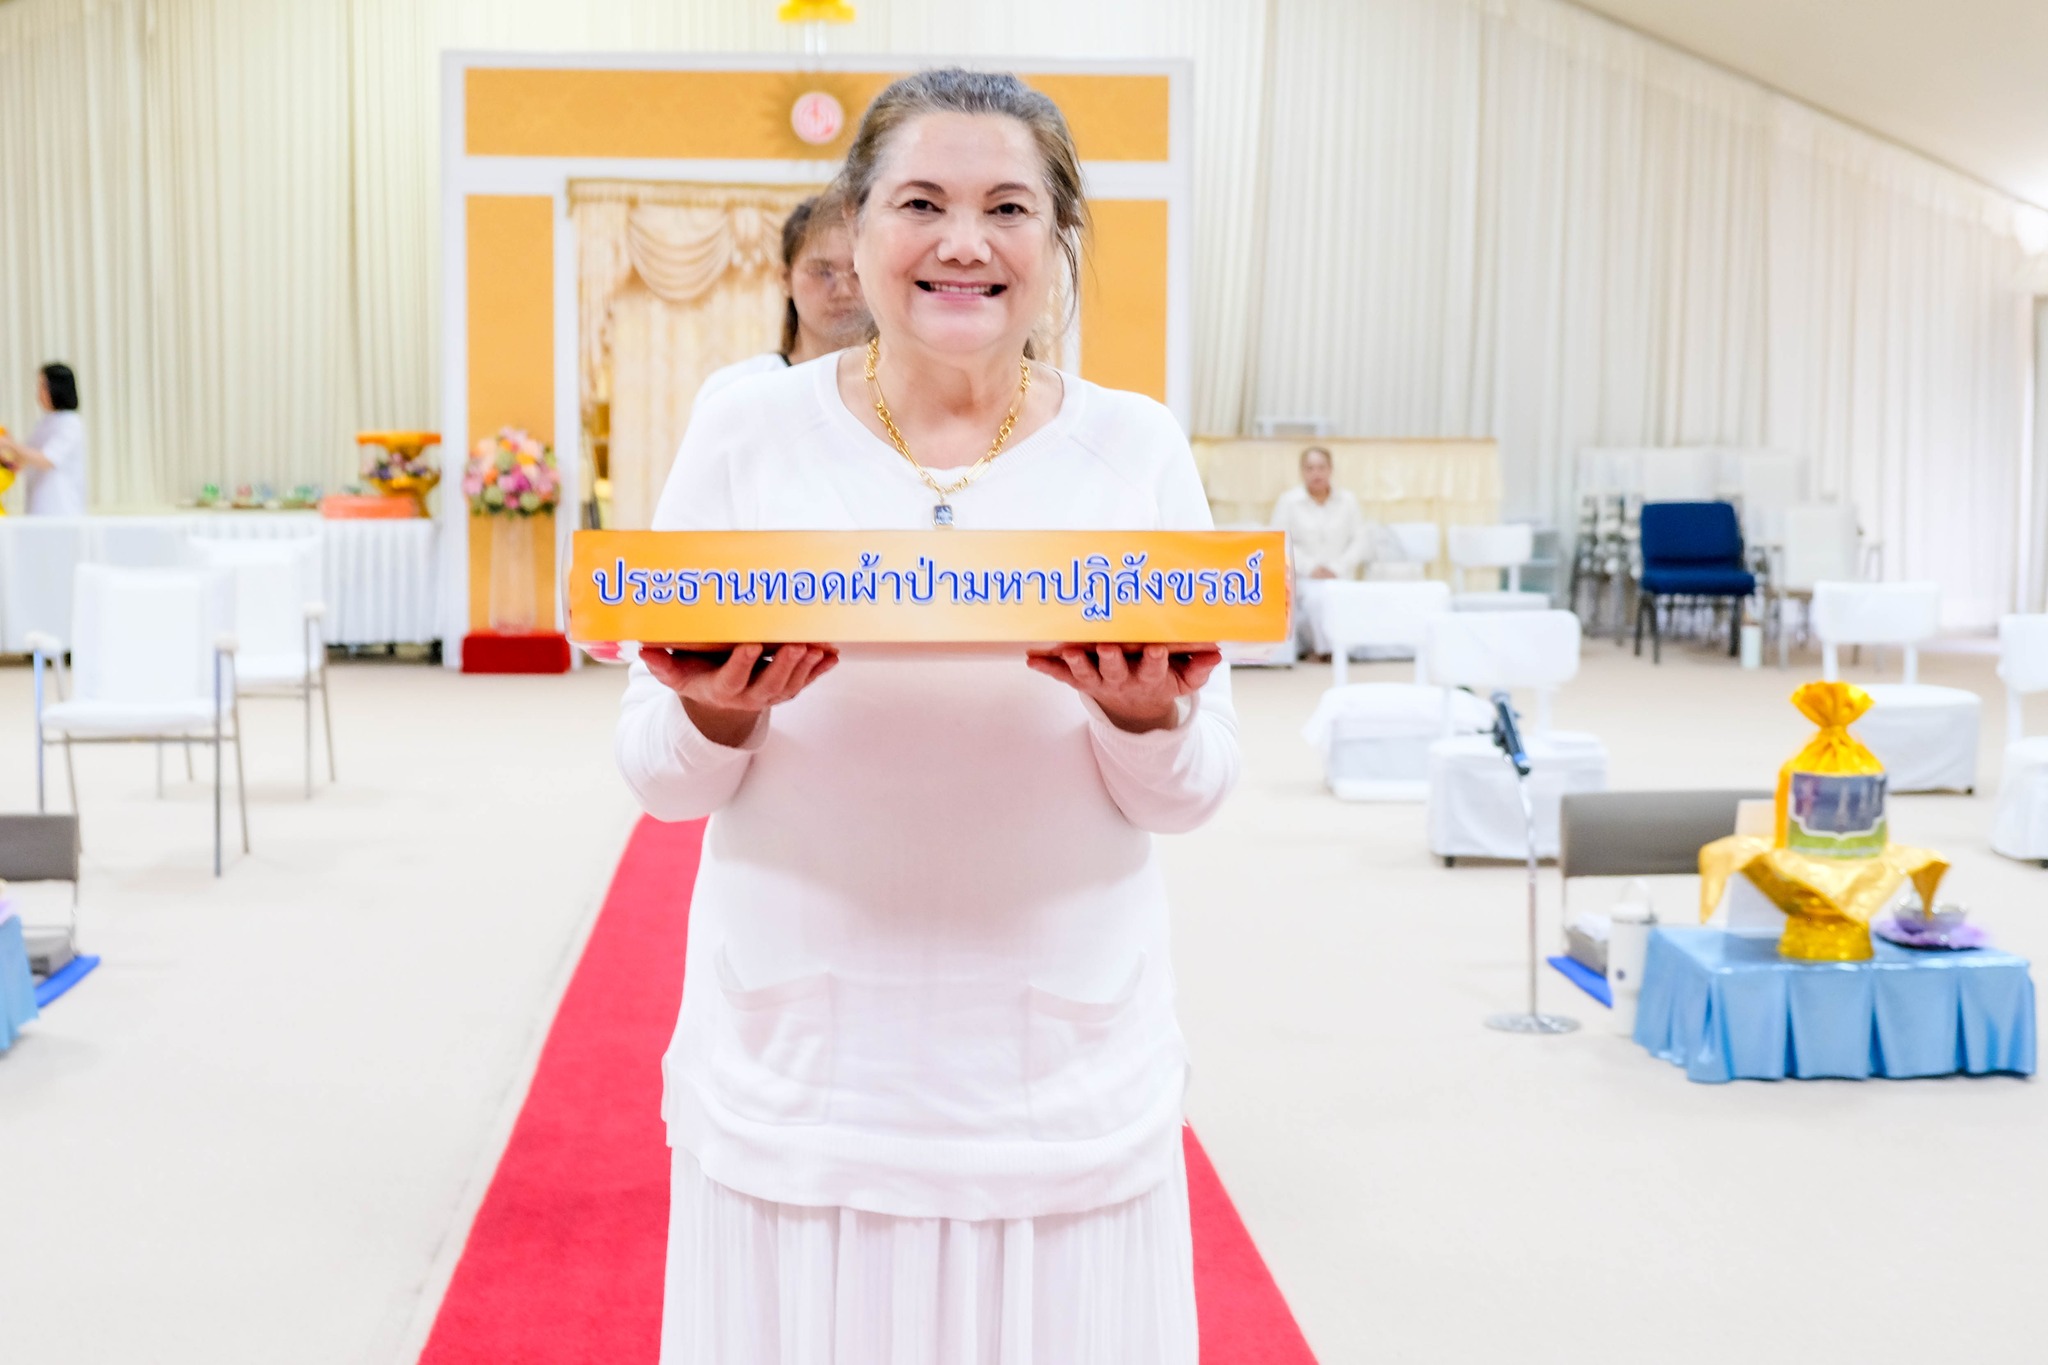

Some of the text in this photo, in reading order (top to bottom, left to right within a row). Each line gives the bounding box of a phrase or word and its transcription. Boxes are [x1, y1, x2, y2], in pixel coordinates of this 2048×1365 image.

[593, 551, 1263, 620] ประธานทอดผ้าป่ามหาปฏิสังขรณ์
